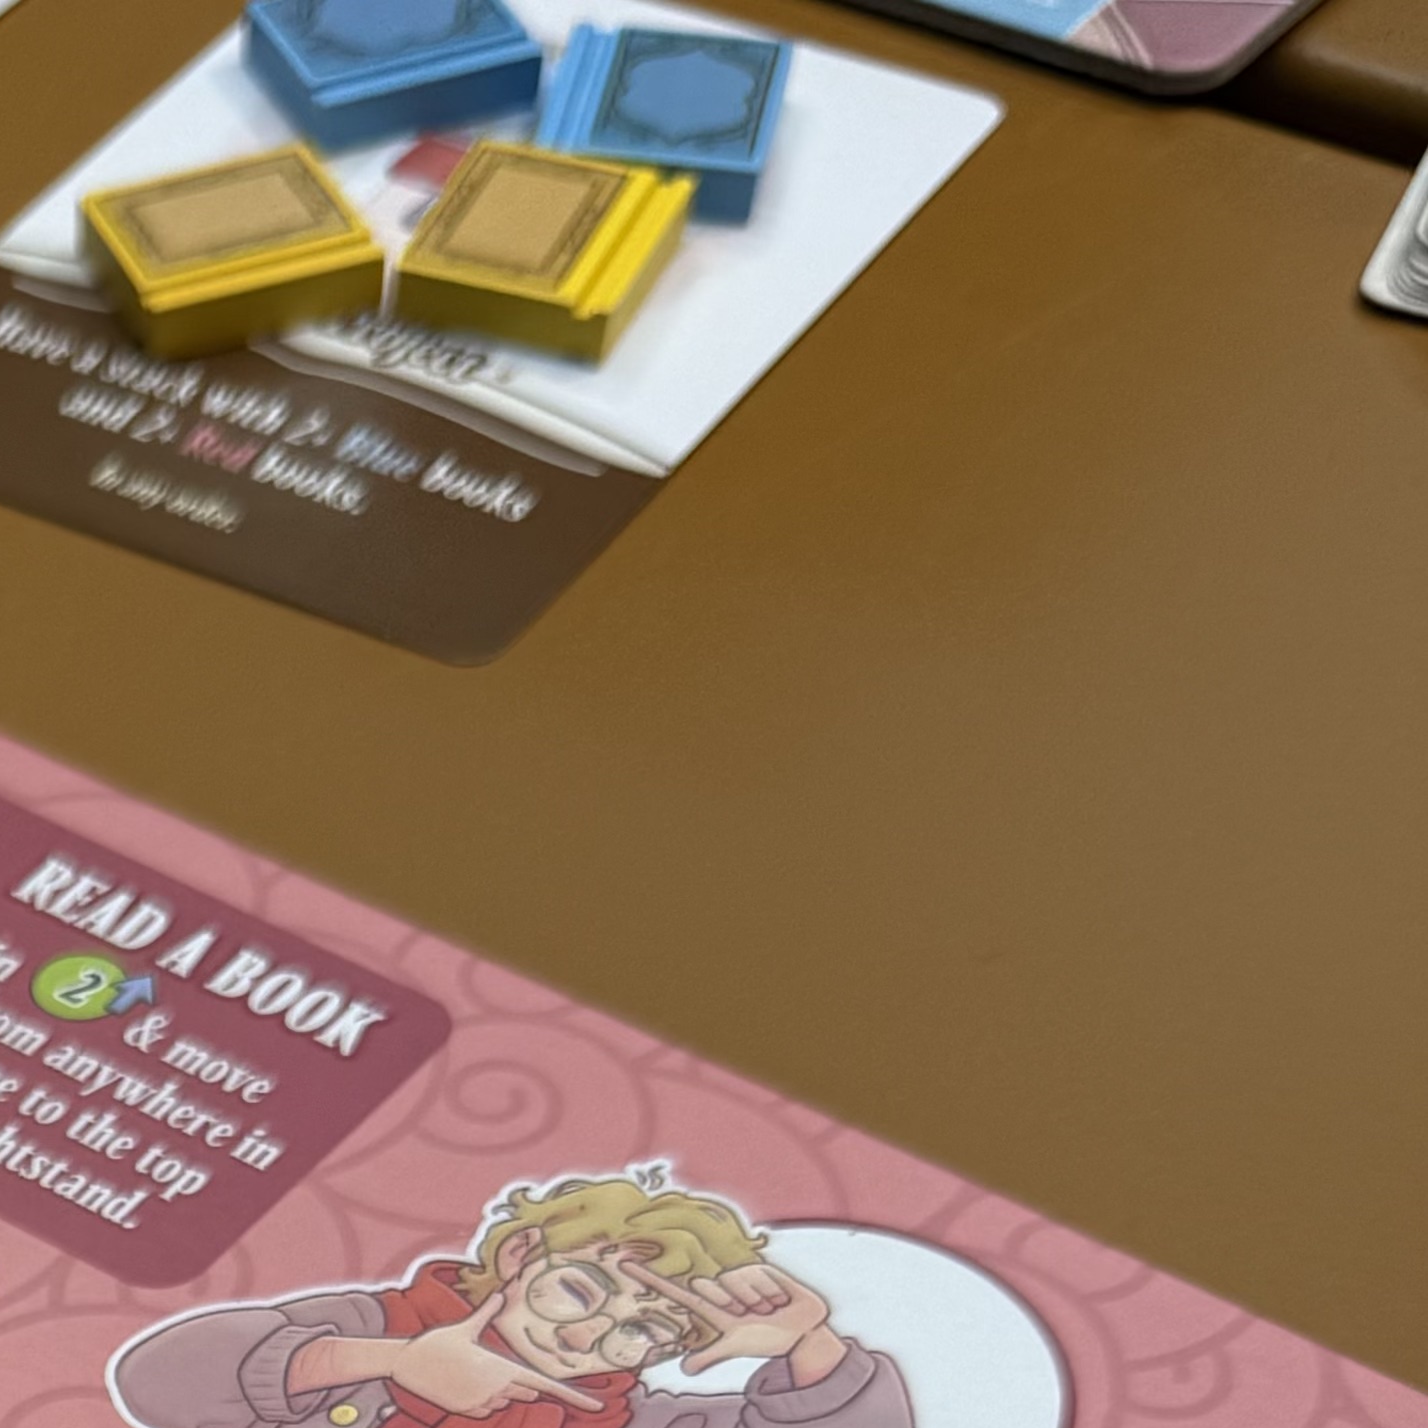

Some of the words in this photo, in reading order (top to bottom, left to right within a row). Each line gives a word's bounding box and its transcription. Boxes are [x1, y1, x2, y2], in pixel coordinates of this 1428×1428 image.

[59, 383, 141, 433] and
[180, 420, 264, 474] Red
[201, 380, 290, 434] with
[334, 420, 424, 482] Blue
[419, 453, 539, 523] books
[12, 857, 172, 951] READ
[156, 929, 216, 978] A
[205, 946, 386, 1060] BOOK
[52, 968, 113, 1009] 2
[123, 1014, 167, 1052] &
[163, 1039, 276, 1105] move
[18, 1085, 69, 1129] to
[65, 1109, 137, 1162] the
[134, 1146, 211, 1204] top
[45, 1042, 236, 1151] anywhere
[230, 1123, 287, 1174] in
